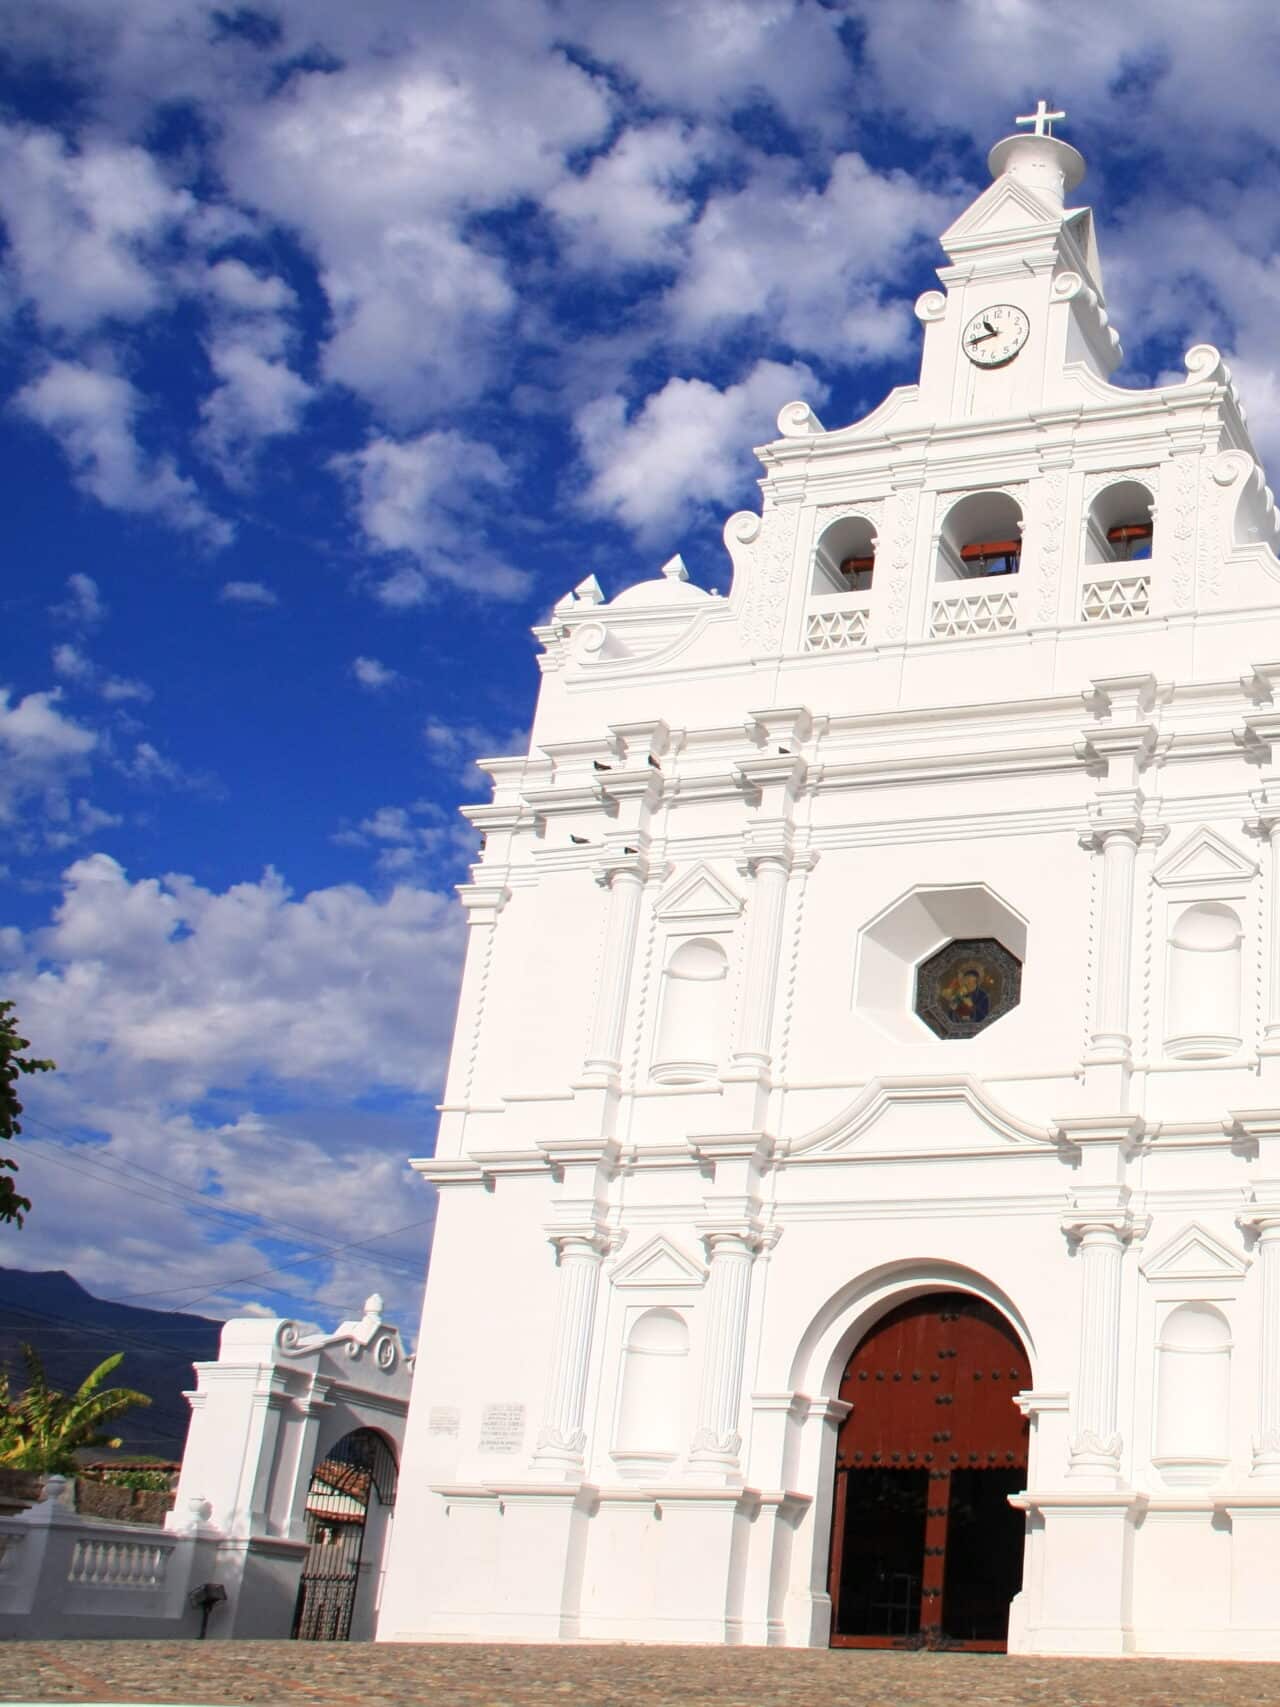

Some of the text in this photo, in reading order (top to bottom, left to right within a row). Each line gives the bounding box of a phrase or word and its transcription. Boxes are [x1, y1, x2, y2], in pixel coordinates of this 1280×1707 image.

[994, 310, 1002, 318] 12
[1014, 317, 1020, 325] 2
[1017, 327, 1022, 335] 3
[1012, 338, 1018, 346] 4
[1003, 346, 1009, 354] 5
